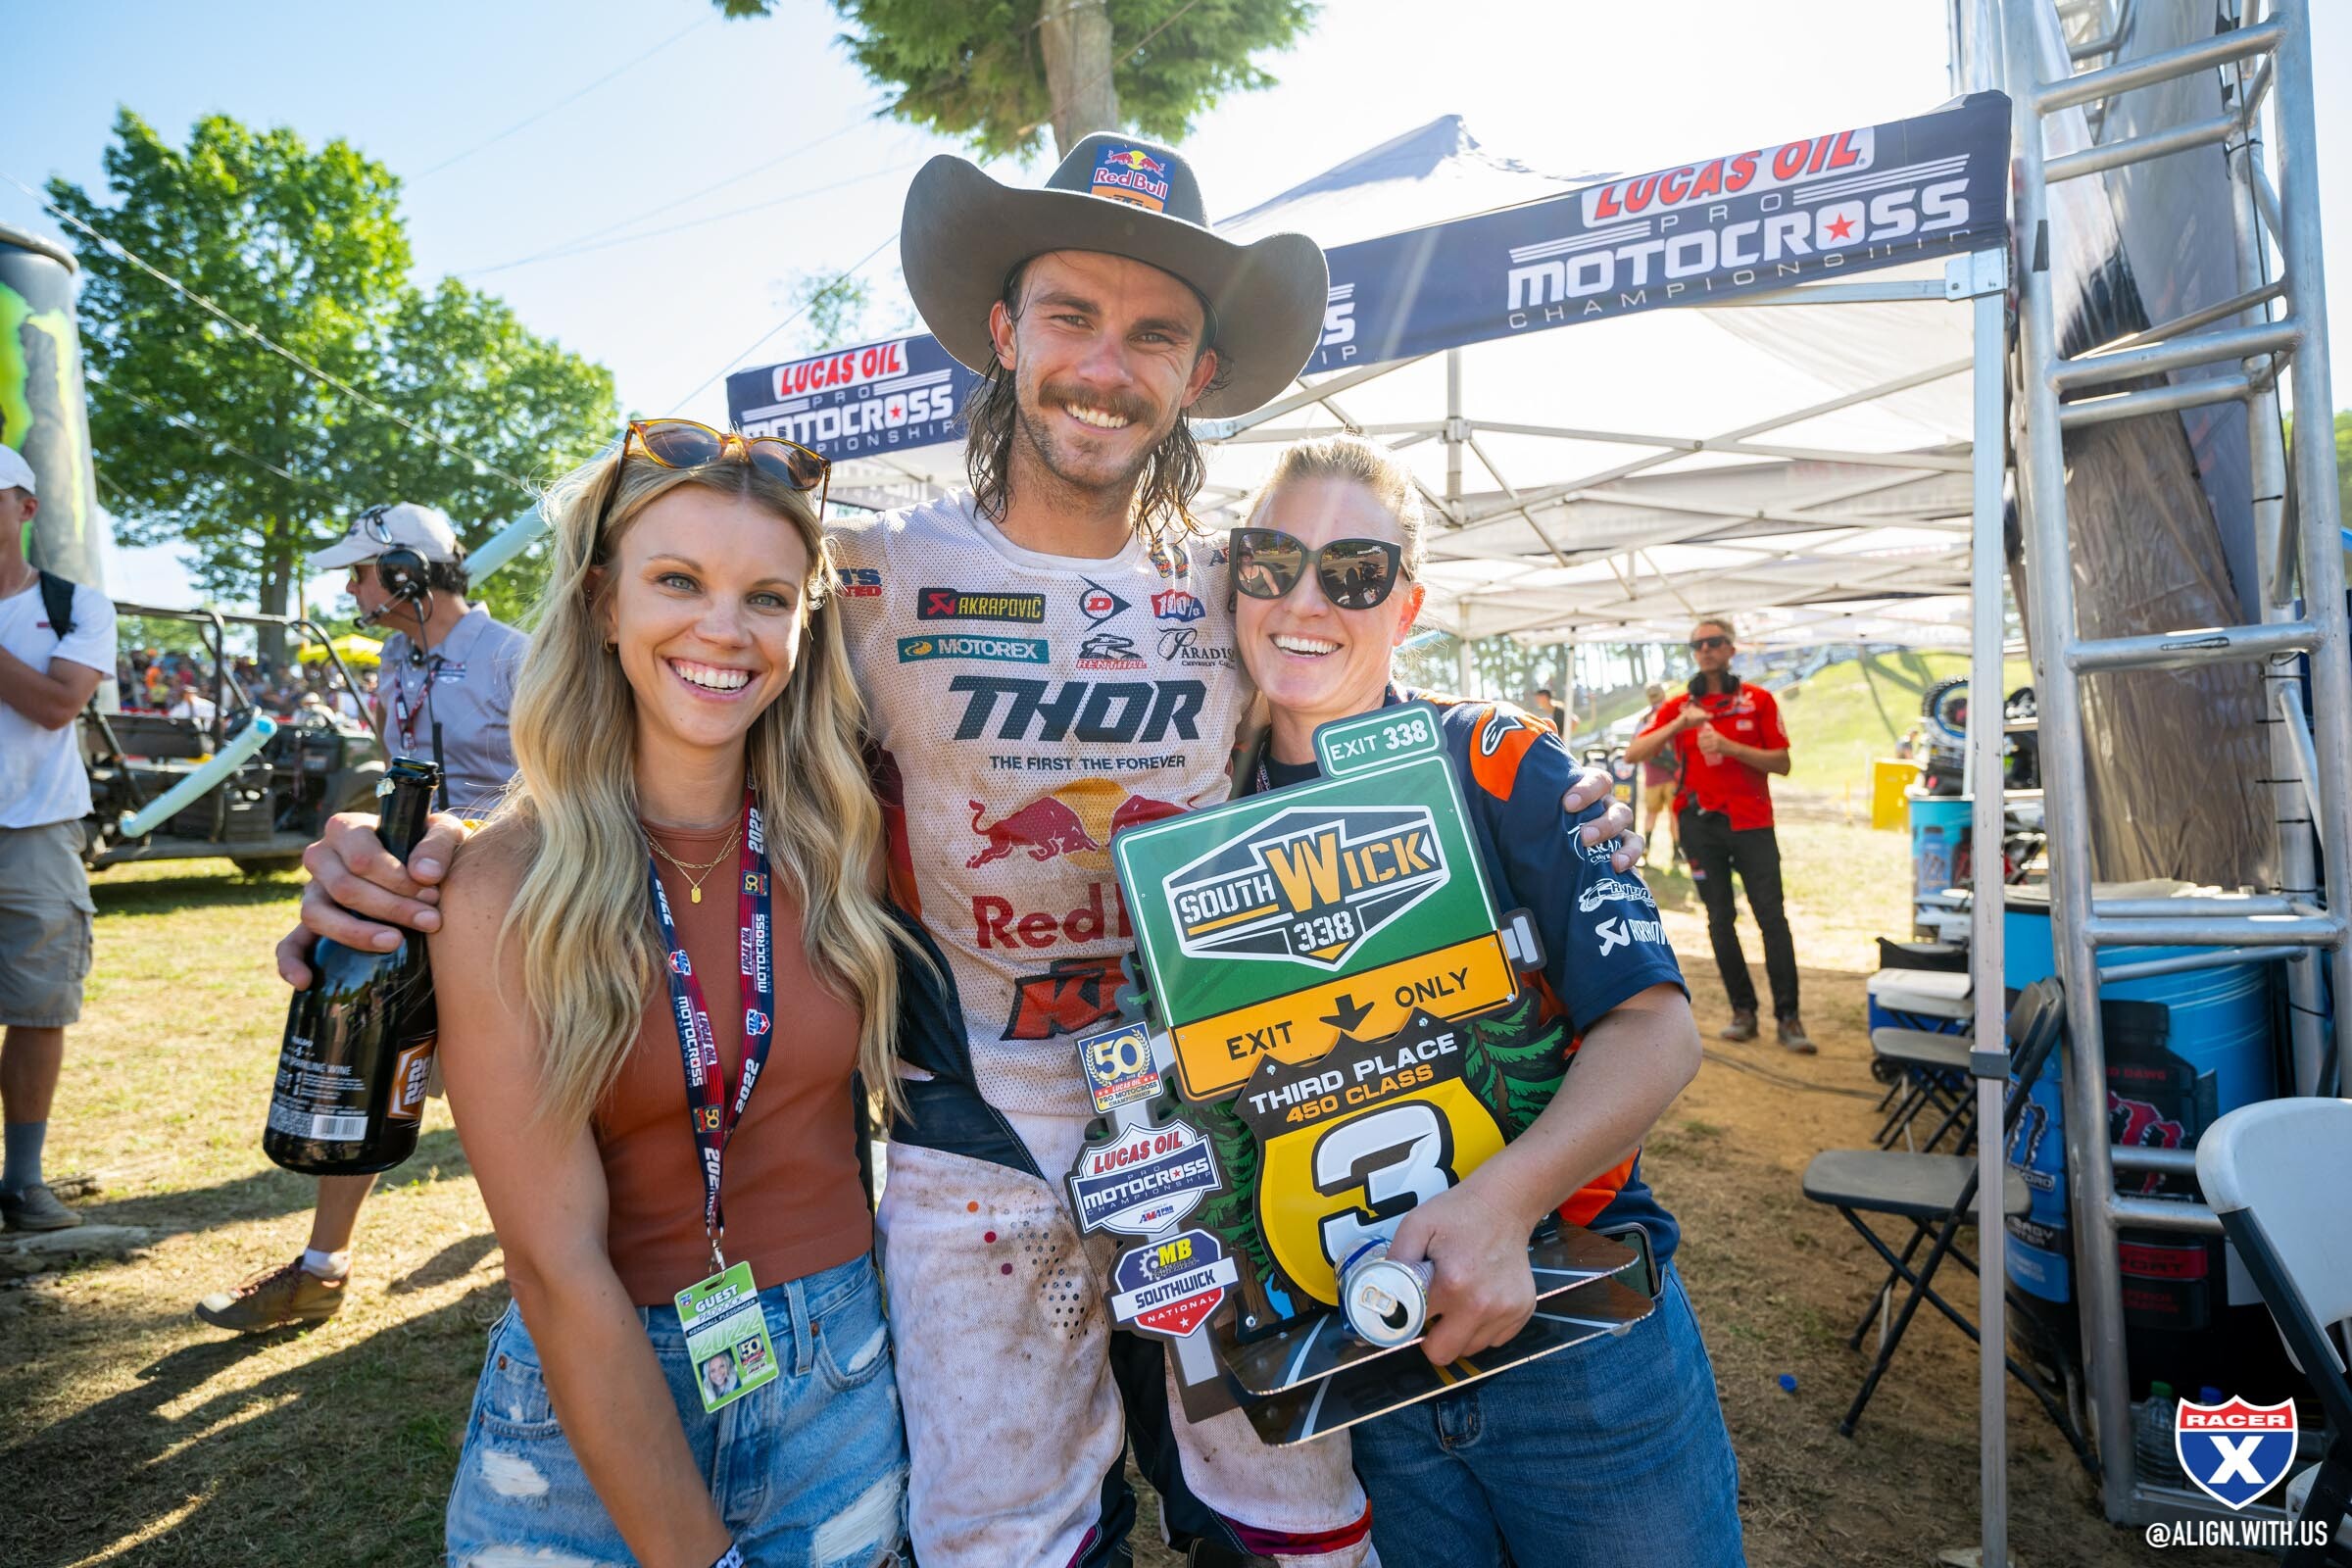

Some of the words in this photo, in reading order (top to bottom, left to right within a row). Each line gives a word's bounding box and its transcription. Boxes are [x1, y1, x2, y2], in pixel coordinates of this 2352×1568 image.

[1094, 168, 1134, 186] Red
[1132, 172, 1168, 199] Bull
[1594, 150, 1763, 220] LUCAS
[1772, 130, 1862, 180] OIL
[1660, 193, 1782, 233] PRO
[1506, 177, 1971, 311] MOTOCROSS
[780, 352, 857, 397] LUCAS
[862, 344, 901, 378] OIL
[812, 385, 870, 409] PRO
[815, 420, 954, 455] PIONSHIP
[1087, 597, 1112, 611] D
[938, 639, 1038, 660] MOTOREX
[1076, 660, 1147, 670] RENTHAL
[949, 675, 1206, 743] THOR
[1330, 735, 1378, 761] EXIT
[1385, 719, 1428, 751] 338
[990, 756, 1025, 770] THE
[1027, 757, 1073, 770] FIRST
[1080, 758, 1114, 770] THE
[1117, 756, 1186, 770] FOREVER
[748, 808, 764, 855] 2022
[745, 874, 758, 892] 50
[742, 929, 751, 944] OIL
[972, 883, 1105, 949] Red
[1294, 910, 1354, 952] 338
[742, 946, 752, 973] LUCAS
[756, 913, 767, 993] MOTOCROSS
[1000, 957, 1129, 1041] KT
[1226, 1021, 1293, 1061] EXIT
[1395, 967, 1469, 1008] ONLY
[678, 996, 704, 1088] MOTOCROSS
[1094, 1036, 1145, 1080] 50
[735, 1058, 760, 1114] 2022
[1112, 1081, 1131, 1092] LUCAS
[1115, 1081, 1157, 1098] MOTOCROSS
[1249, 1070, 1345, 1114] THIRD
[1352, 1032, 1458, 1082] PLACE
[1286, 1096, 1339, 1123] 450
[1346, 1063, 1435, 1105] CLASS
[706, 1108, 719, 1129] 50
[705, 1147, 720, 1190] 202
[1094, 1140, 1151, 1175] LUCAS
[1154, 1131, 1183, 1154] OIL
[1128, 1165, 1160, 1180] PRO
[1083, 1157, 1209, 1210] MOTOCROSS
[1087, 1171, 1211, 1216] CHAMPIONSHIP
[1317, 1104, 1450, 1265] 3
[1140, 1208, 1161, 1224] AMA
[1157, 1238, 1193, 1267] MB
[696, 1284, 738, 1313] GUEST
[699, 1296, 742, 1323] PADDOCK
[1135, 1269, 1216, 1309] SOUTHWICK
[1148, 1296, 1215, 1323] NATIONAL
[695, 1310, 760, 1361] 2022
